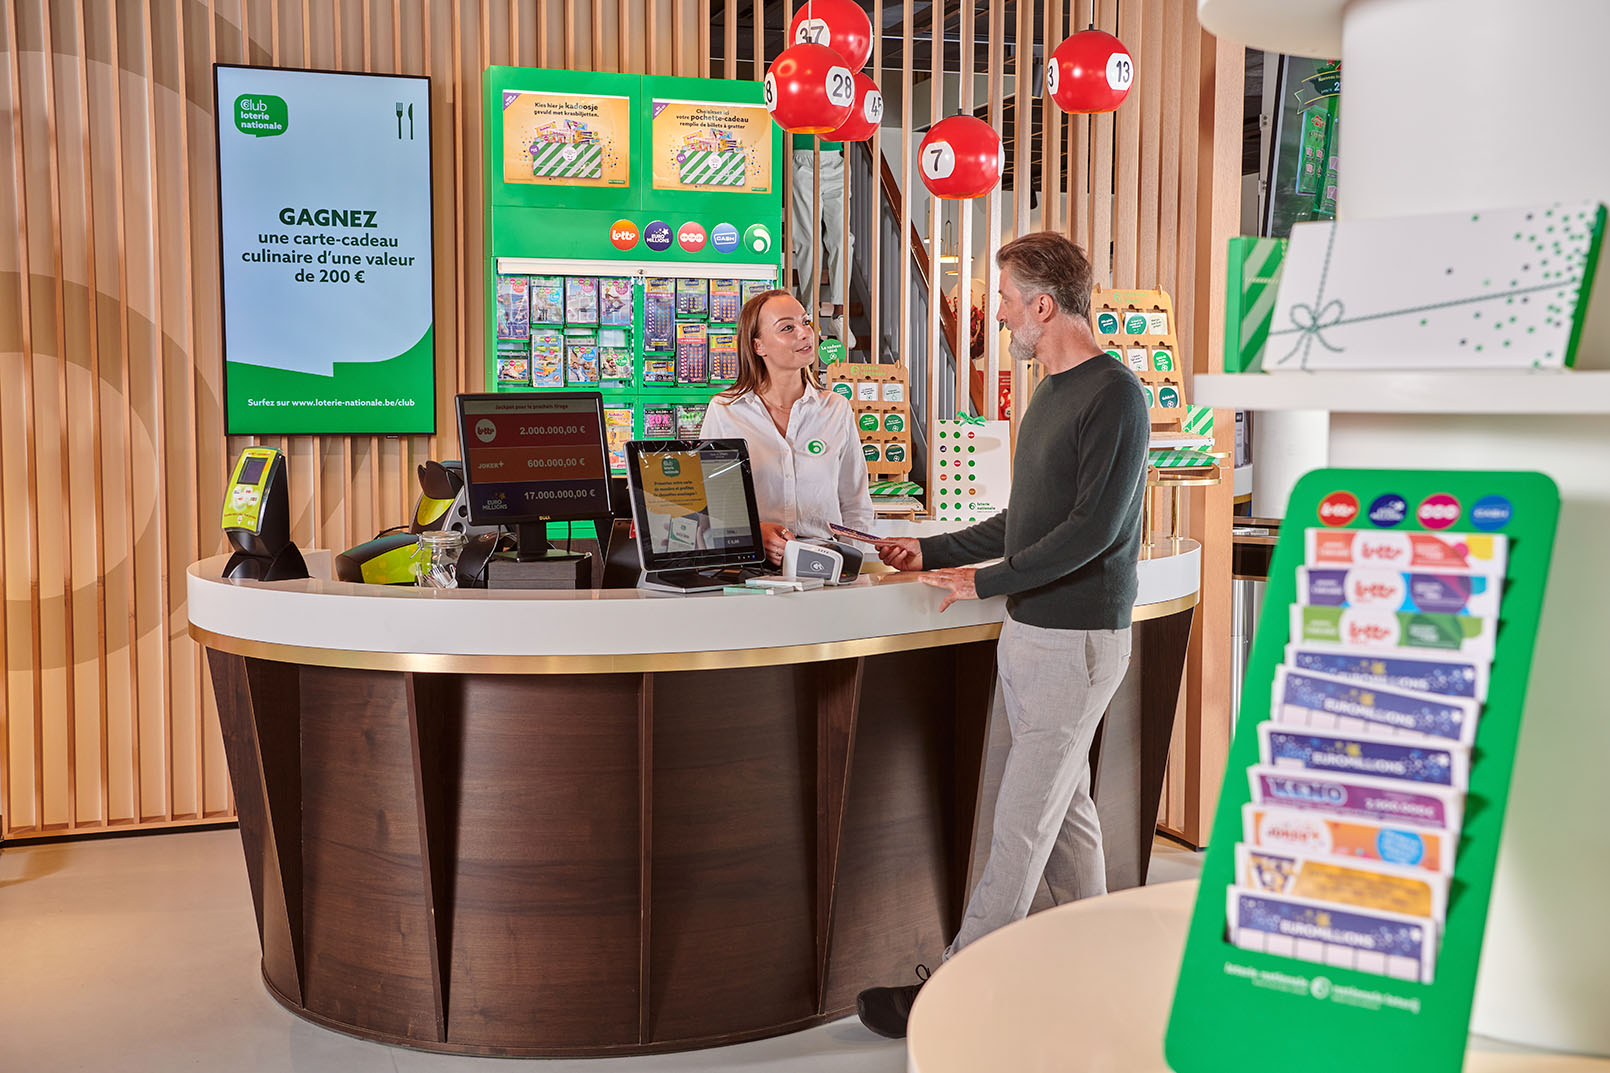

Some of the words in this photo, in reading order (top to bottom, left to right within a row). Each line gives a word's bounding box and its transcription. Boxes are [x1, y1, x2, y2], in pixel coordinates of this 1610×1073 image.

[1116, 60, 1130, 83] 13
[832, 74, 852, 99] 28
[240, 111, 269, 120] loterie
[691, 114, 748, 122] pochette-cadeau
[241, 121, 282, 130] nationale
[930, 149, 943, 172] 7
[279, 208, 377, 228] GAGNEZ
[258, 234, 289, 244] une
[294, 232, 398, 247] carte-cadeau
[242, 249, 312, 264] culinaire
[317, 250, 361, 265] d'une
[366, 252, 415, 266] valeur
[295, 269, 315, 282] de
[320, 270, 350, 283] 200
[355, 270, 365, 283] €
[248, 398, 274, 406] Surfez
[292, 398, 415, 407] www.loterie-nationale.be/club
[520, 426, 578, 435] 2.000.000,00
[528, 458, 577, 468] 600.000,00
[524, 490, 587, 500] 17.000.000,00
